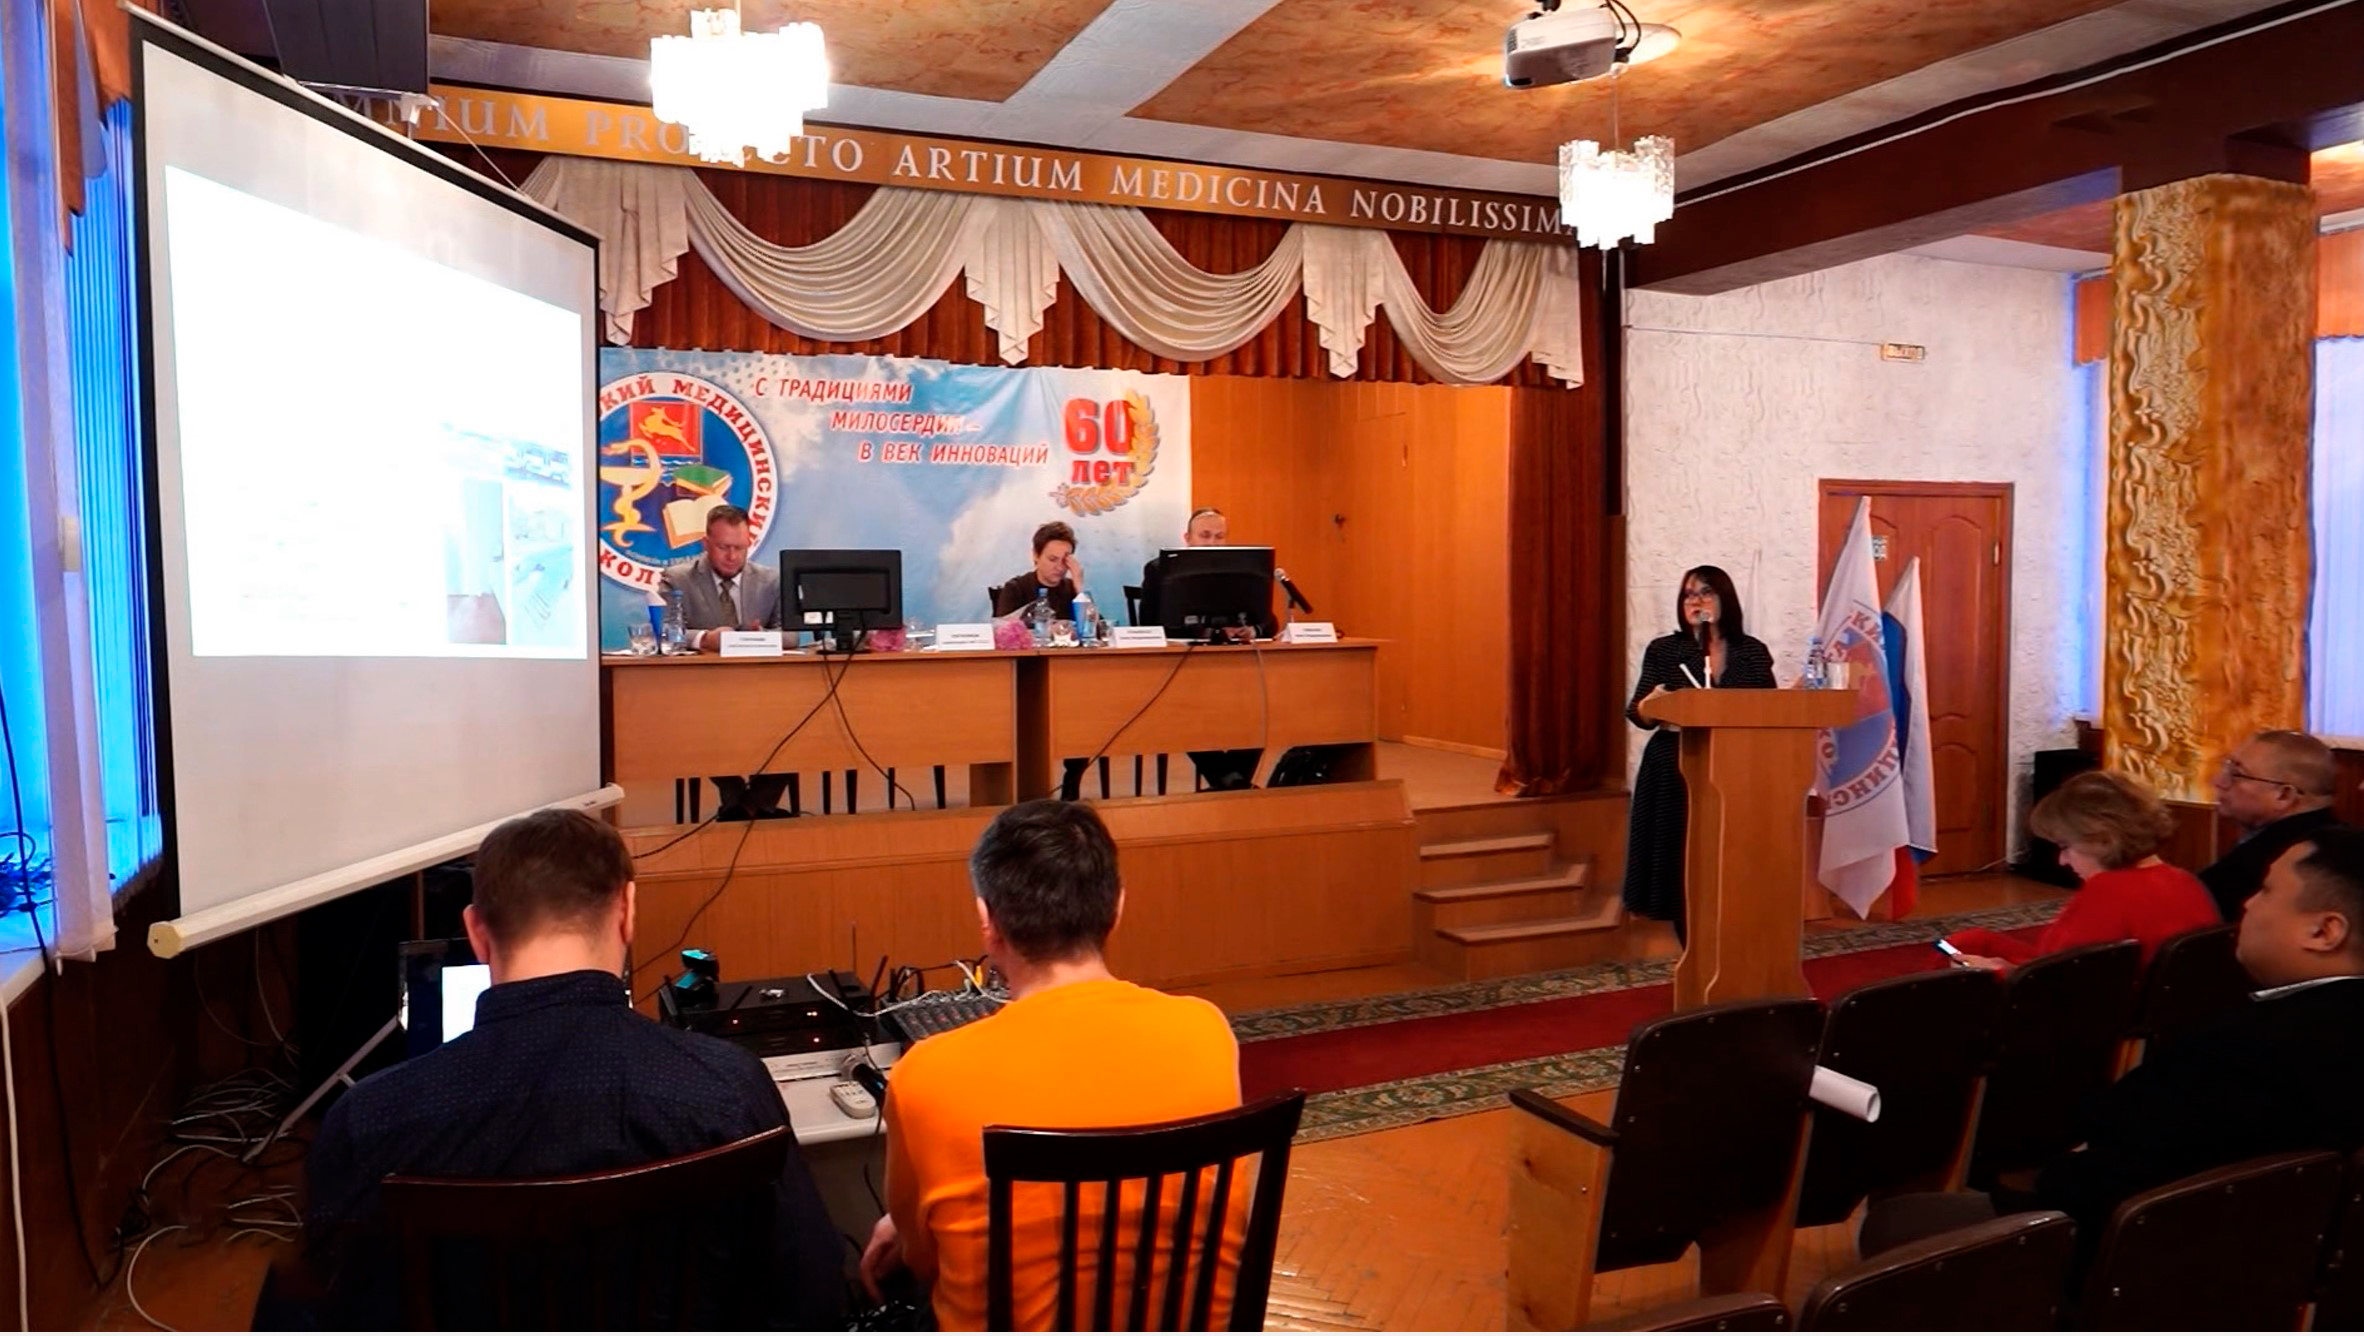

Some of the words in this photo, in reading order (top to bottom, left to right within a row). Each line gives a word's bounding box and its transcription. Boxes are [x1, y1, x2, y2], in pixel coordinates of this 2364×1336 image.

[584, 109, 864, 172] PROTO
[892, 144, 1084, 192] ARTIUM
[1110, 164, 1327, 215] MEDICINA
[1350, 188, 1574, 236] NOBILISSIM
[599, 375, 656, 411] КИЙ
[755, 377, 768, 397] С
[778, 378, 913, 404] ТРАДИЦИЯМИ
[1065, 397, 1136, 456] 60
[860, 441, 873, 461] В
[883, 443, 922, 462] ВЕК
[932, 443, 1049, 465] ИННОВАЦИЙ
[1071, 460, 1136, 487] лет
[599, 549, 662, 585] КОЛ
